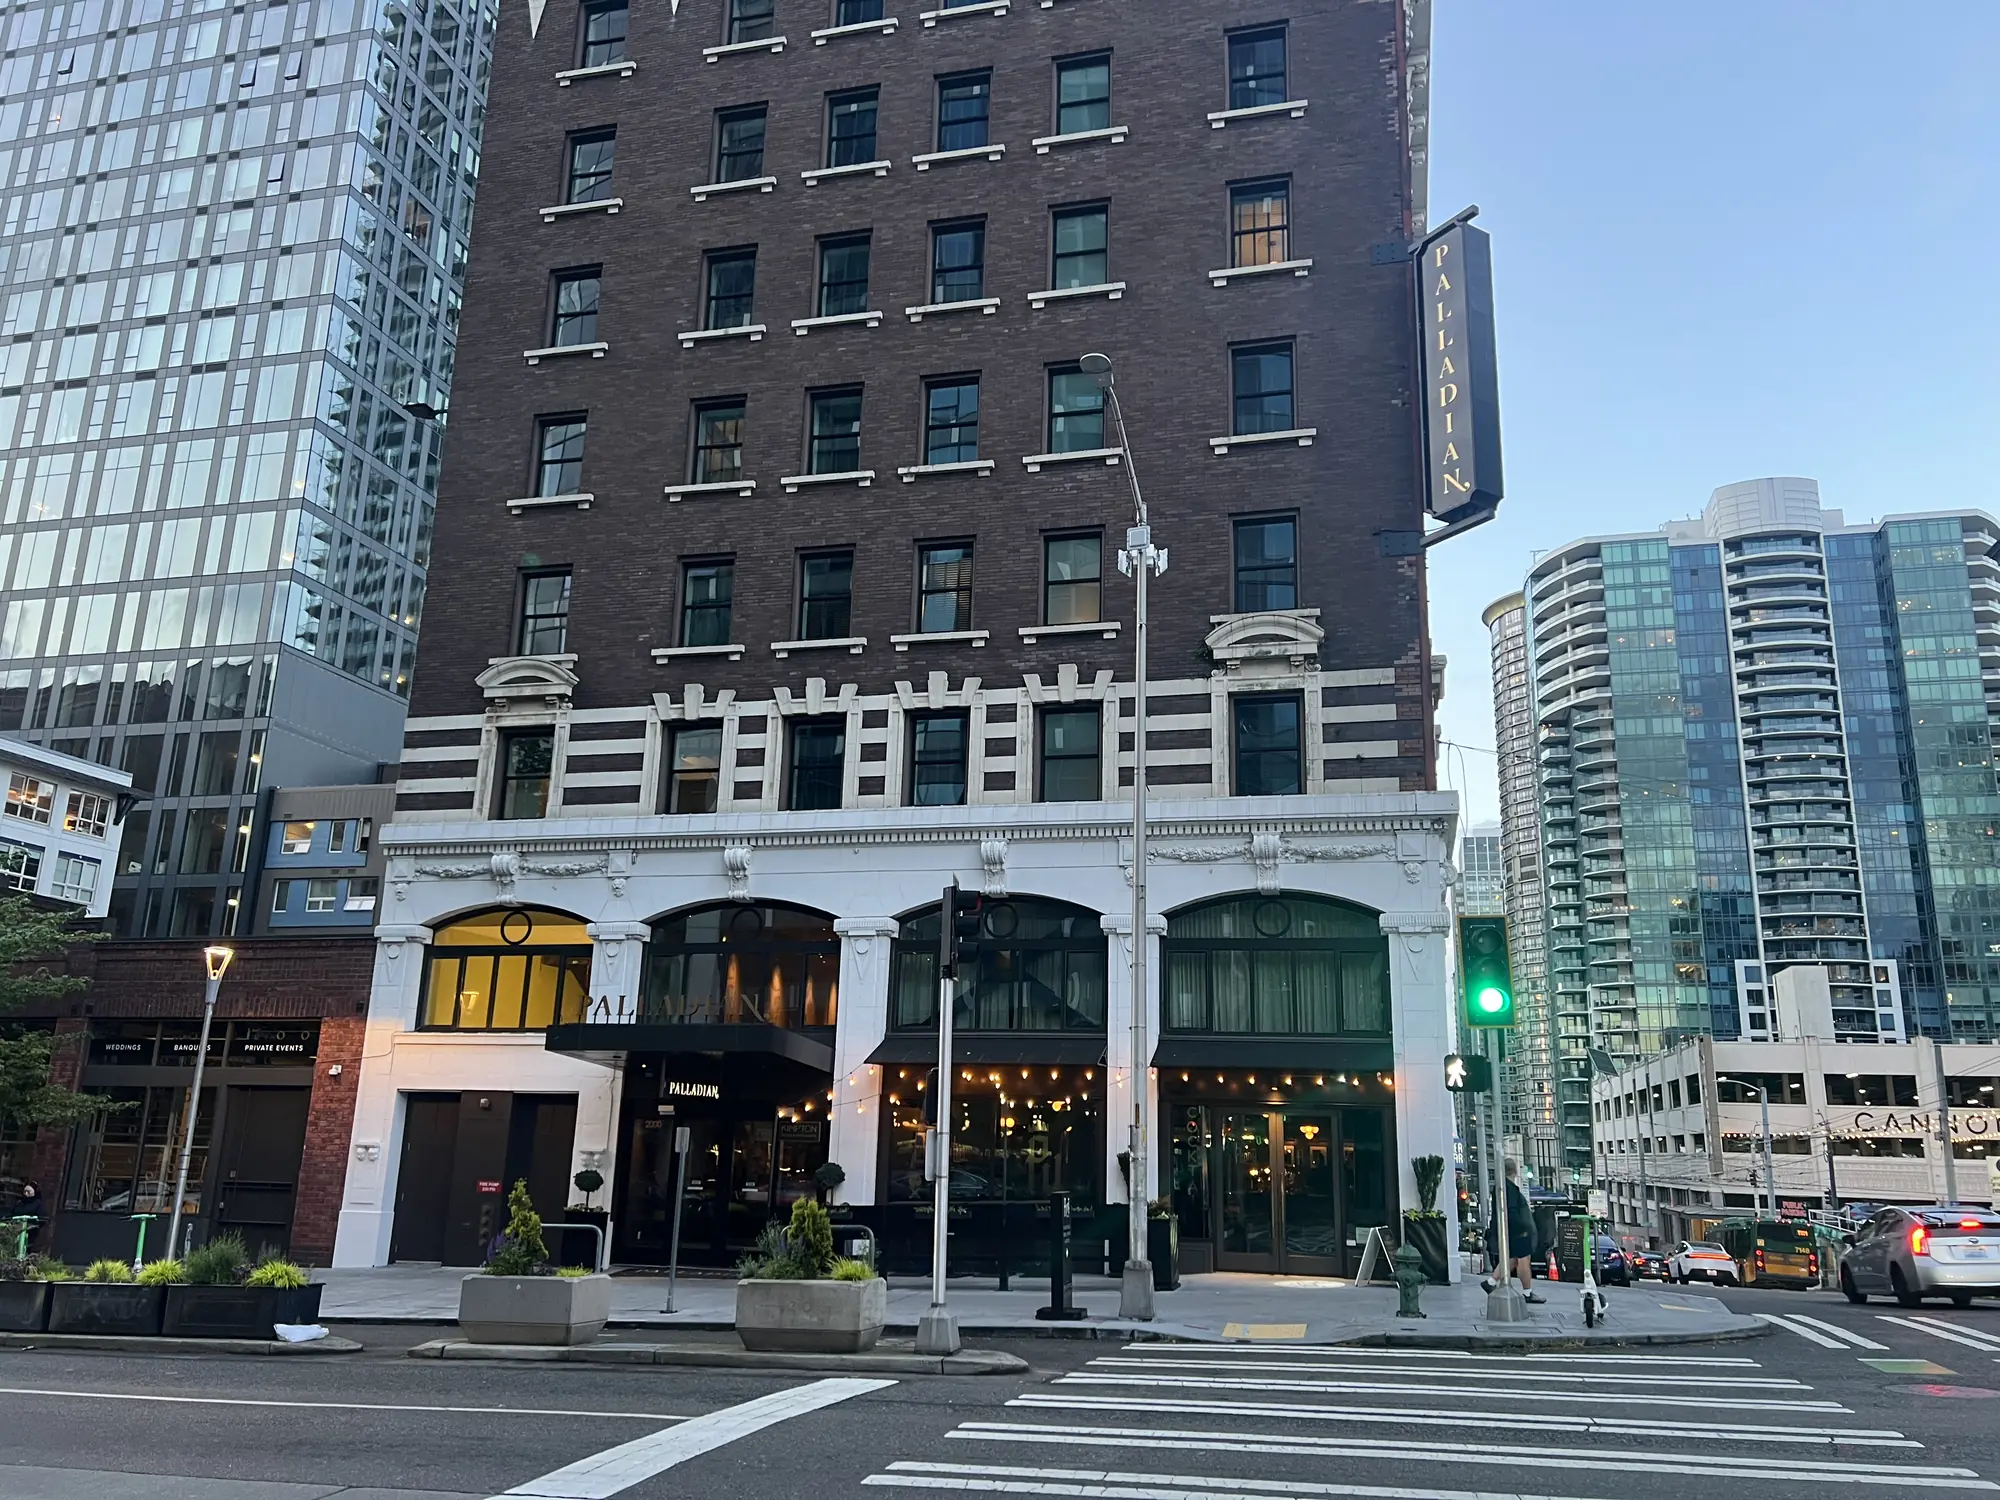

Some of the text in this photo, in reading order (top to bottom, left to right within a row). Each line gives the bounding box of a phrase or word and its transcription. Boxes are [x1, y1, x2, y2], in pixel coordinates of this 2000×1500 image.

[1435, 244, 1471, 494] PALLADIAN
[105, 1043, 142, 1051] WEDDINGS
[173, 1043, 211, 1051] BANQUS
[275, 1044, 304, 1052] EVENTS
[668, 1080, 720, 1100] PALLADIAN
[1854, 1111, 2000, 1135] CANNO
[1186, 1106, 1199, 1196] COCKTA
